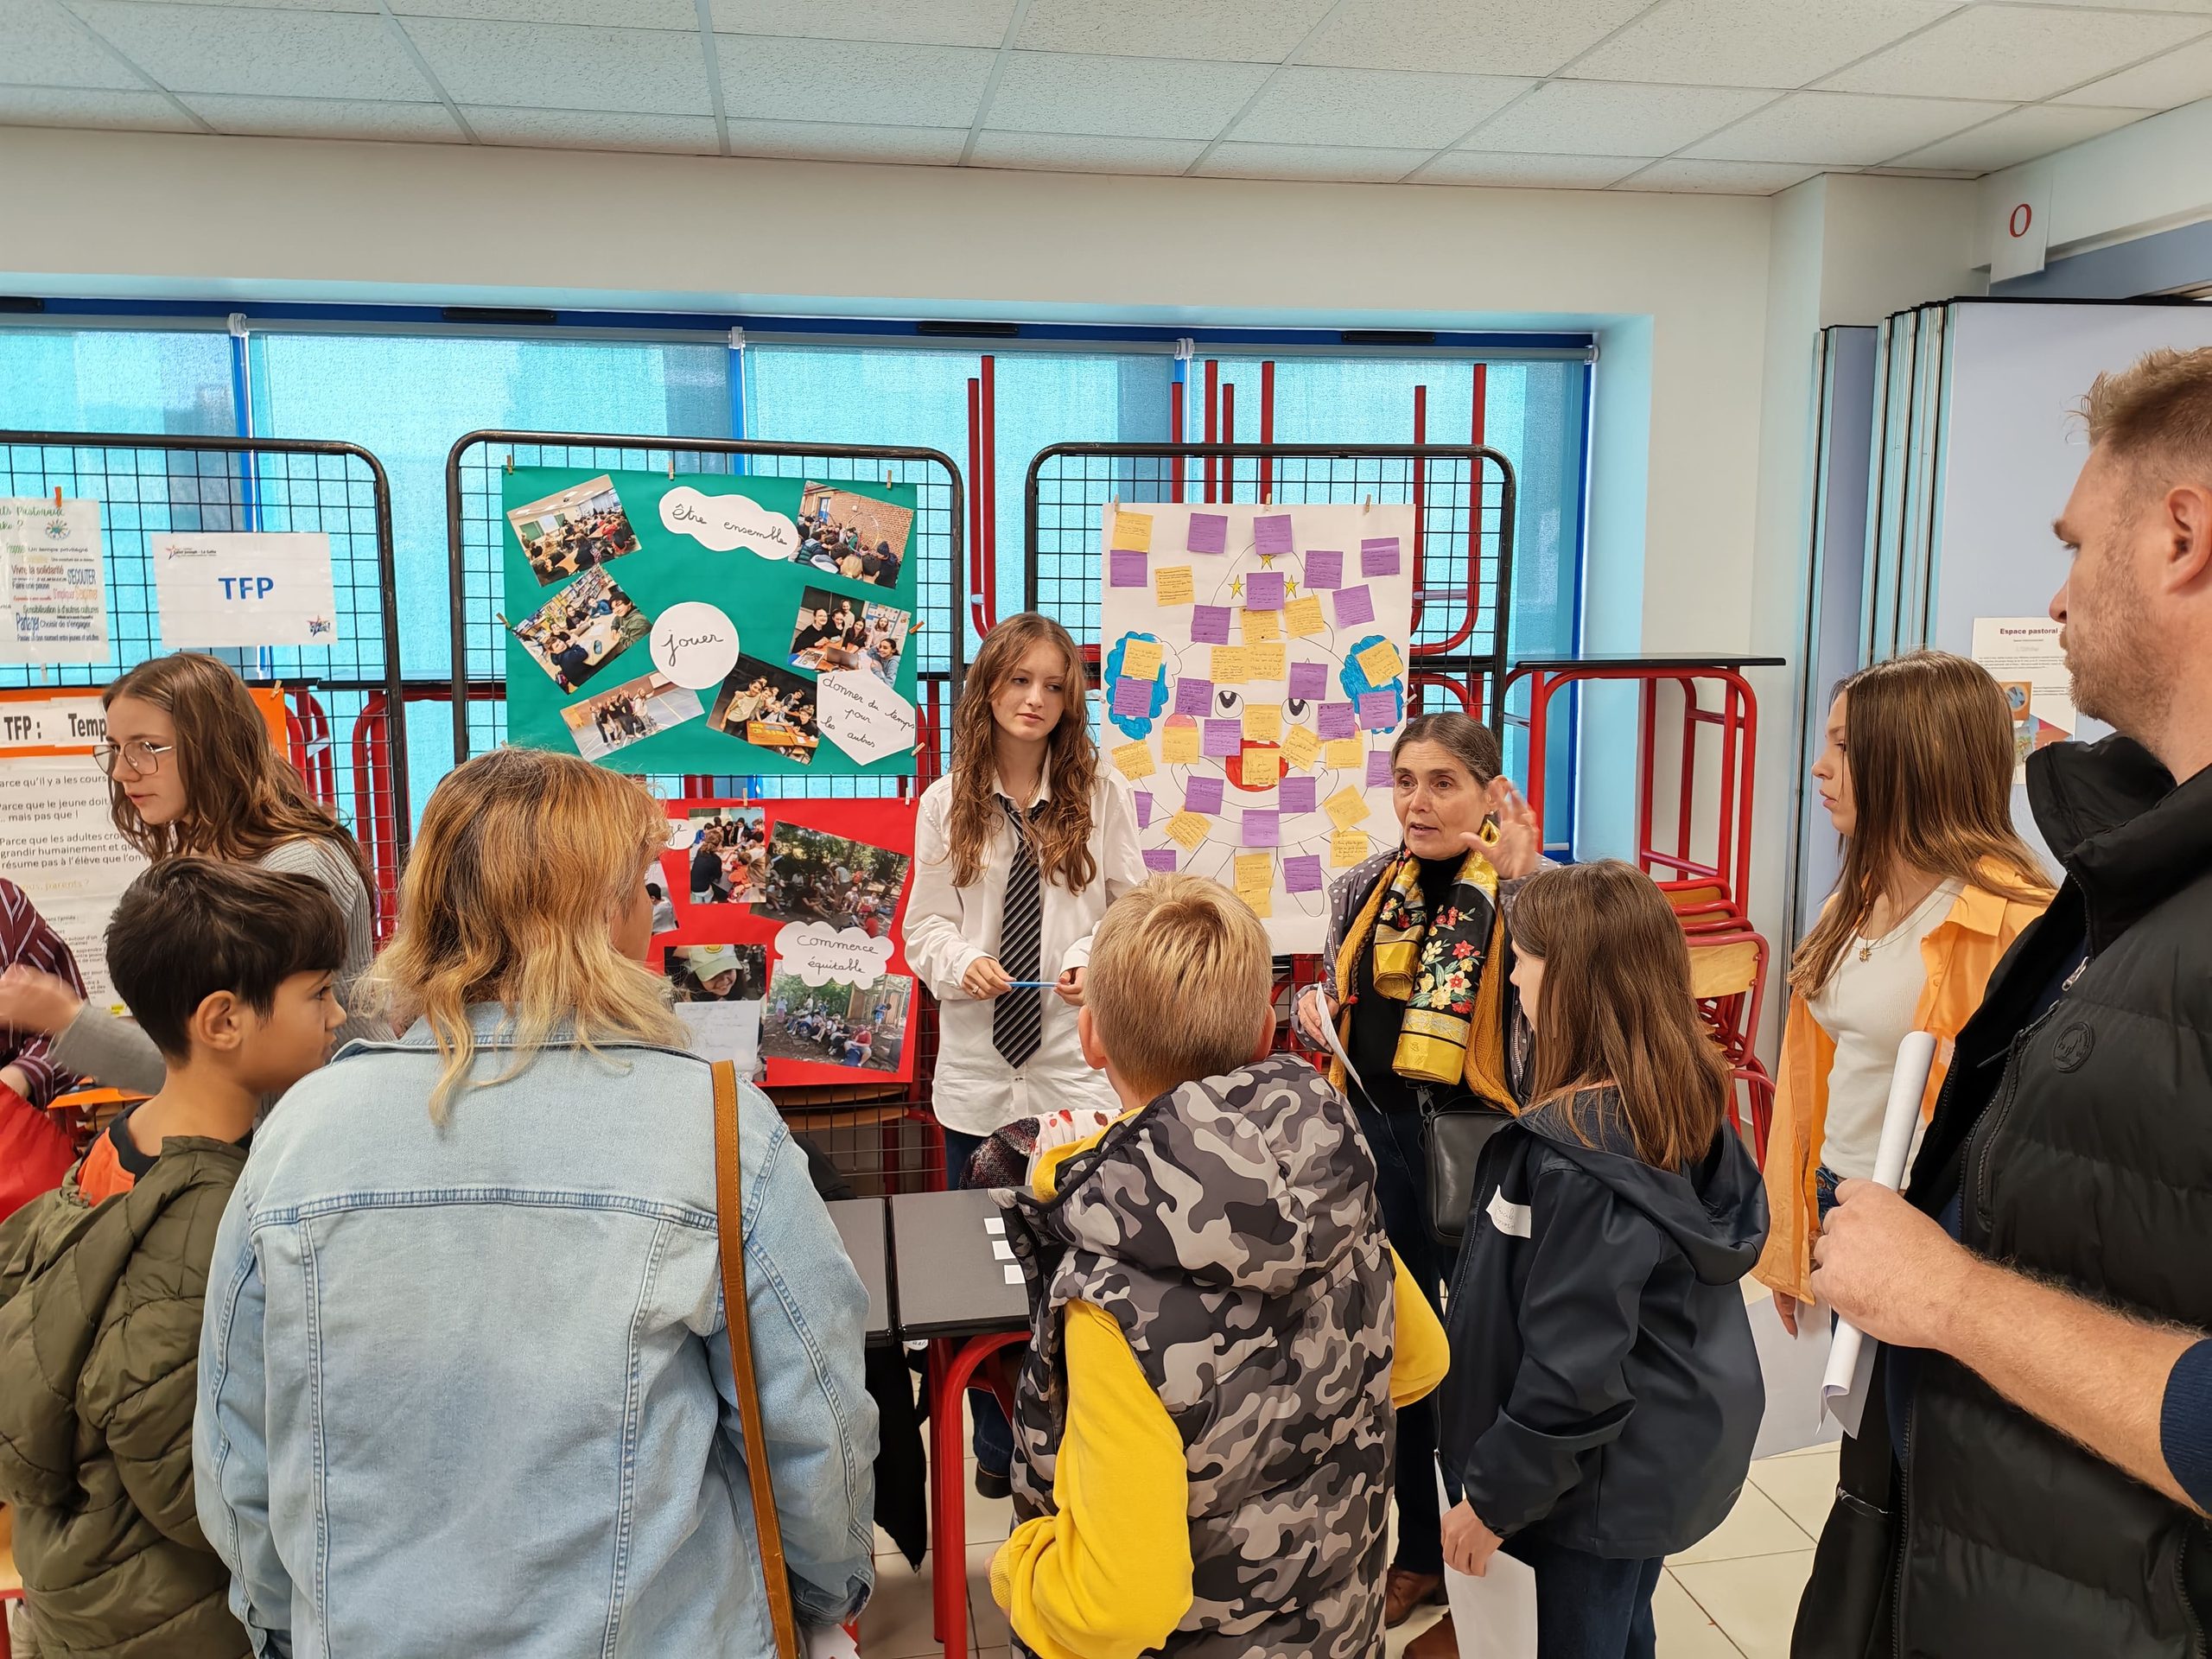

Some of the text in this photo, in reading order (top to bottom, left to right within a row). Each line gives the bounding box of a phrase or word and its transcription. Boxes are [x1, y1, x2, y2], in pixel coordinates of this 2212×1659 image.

[724, 520, 787, 545] ensemble
[36, 563, 64, 575] solidarité
[218, 576, 274, 601] TFP
[1999, 627, 2058, 636] Espace pastoral
[661, 630, 724, 667] jouer
[823, 676, 915, 732] donner du temps
[820, 715, 836, 730] les
[844, 709, 872, 724] pour
[3, 713, 107, 742] TFP : Temp
[847, 732, 875, 747] autres
[23, 777, 45, 788] qu'il
[48, 779, 53, 787] y
[64, 775, 78, 785] les
[79, 775, 107, 784] cours
[0, 798, 108, 811] arce que le jeune doit
[9, 812, 31, 823] mais
[35, 813, 51, 823] pas
[54, 811, 73, 822] que
[0, 837, 27, 846] Parce
[29, 836, 48, 848] que
[51, 834, 64, 843] les
[67, 832, 102, 842] adultes
[1, 848, 36, 859] grandir
[38, 843, 106, 856] humainement
[108, 843, 118, 852] et
[1, 853, 141, 870] résume pas à l'élève que l'on
[22, 882, 43, 891] ous,
[45, 880, 83, 892] parents
[797, 934, 879, 955] Commerce
[807, 956, 866, 976] équitable
